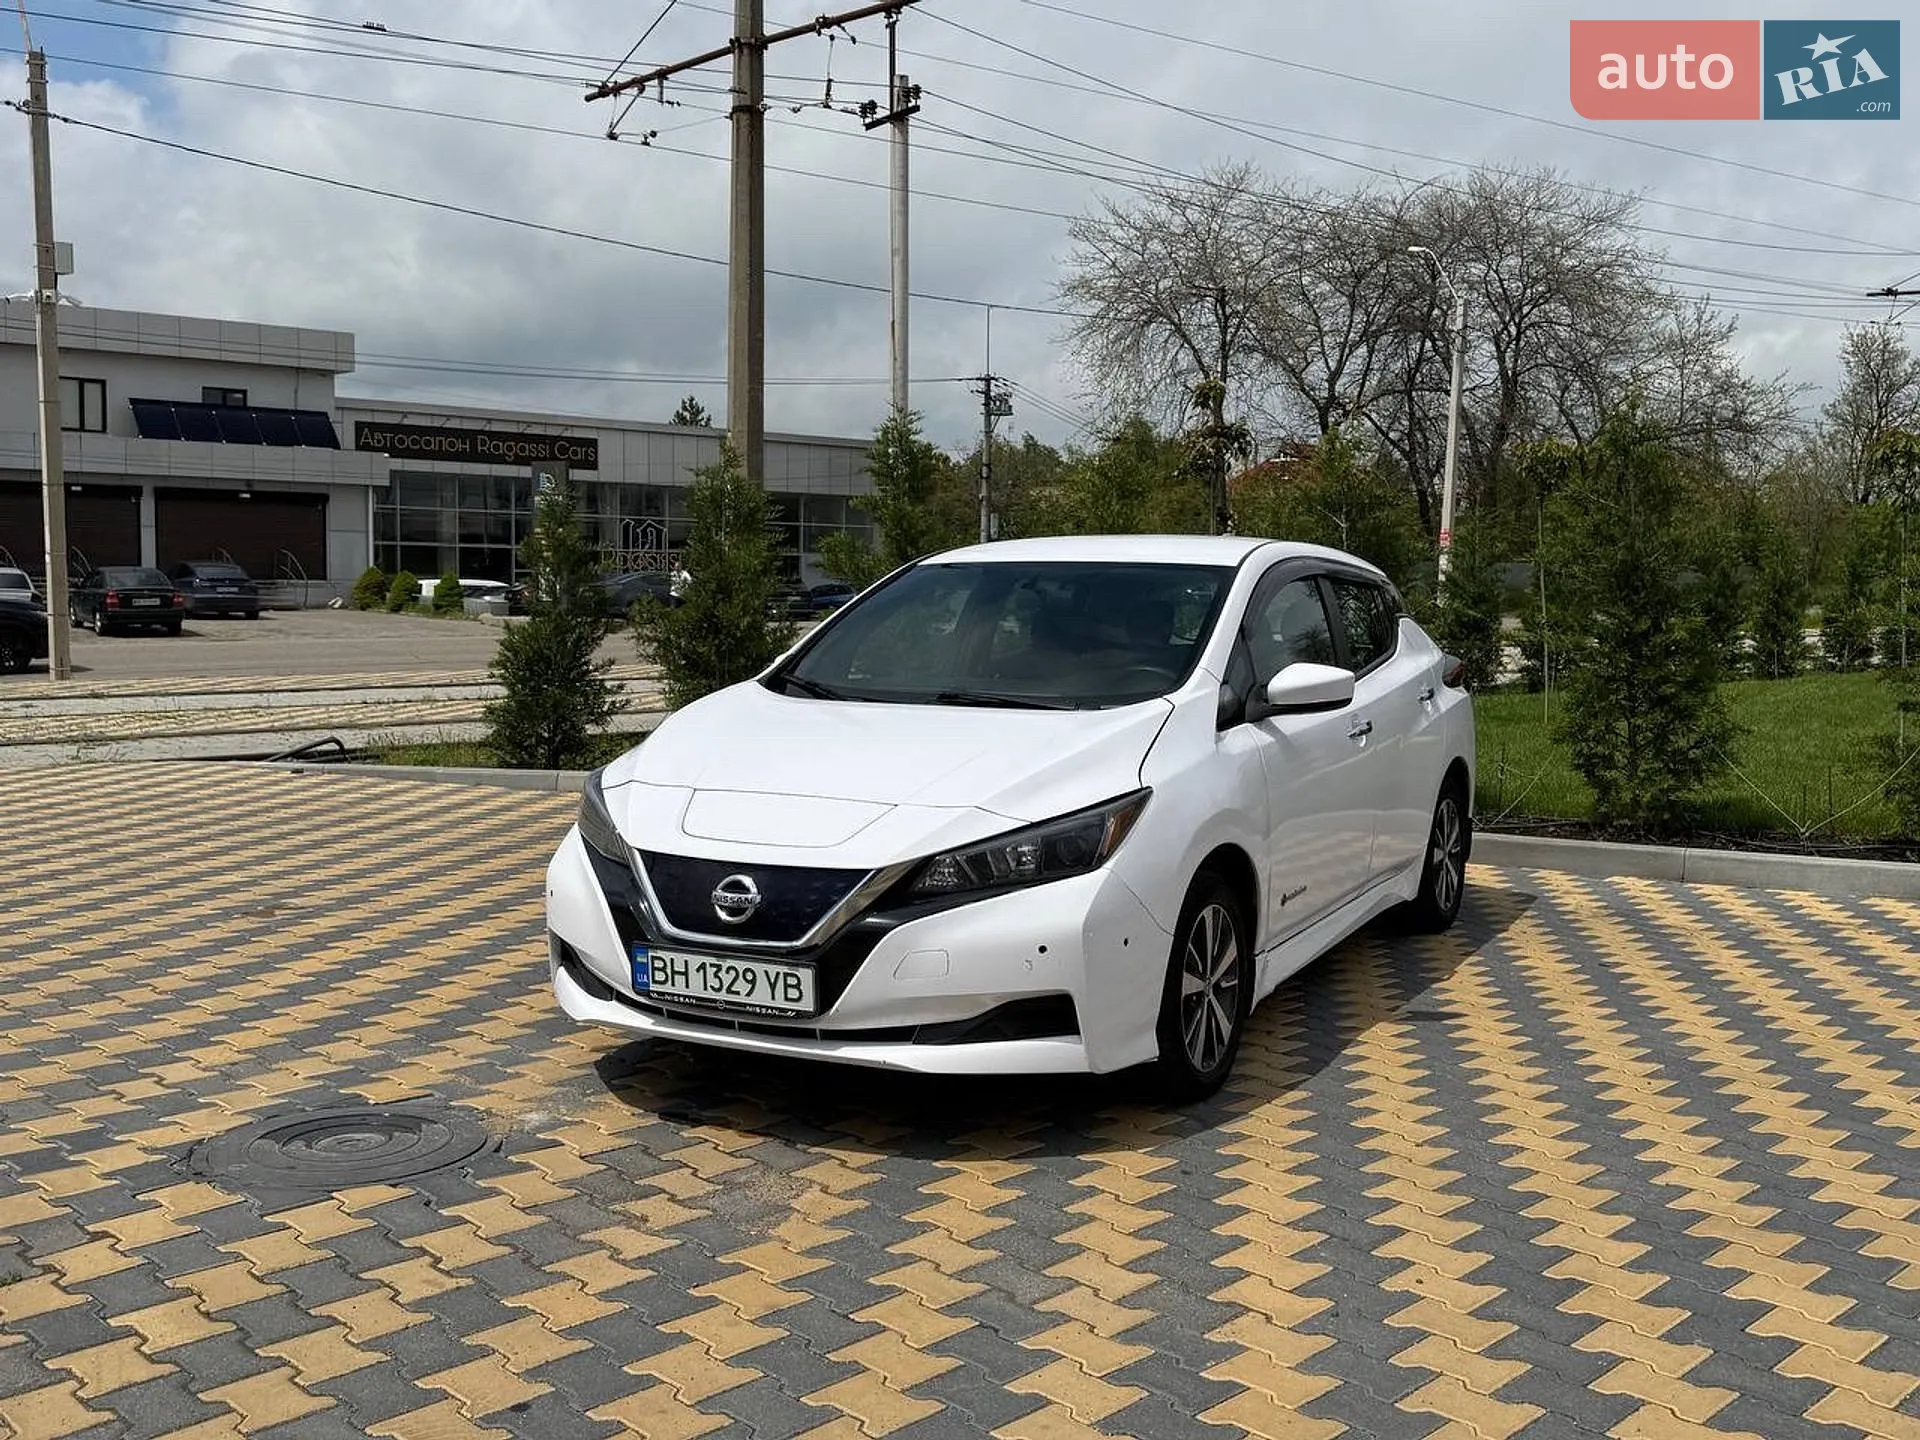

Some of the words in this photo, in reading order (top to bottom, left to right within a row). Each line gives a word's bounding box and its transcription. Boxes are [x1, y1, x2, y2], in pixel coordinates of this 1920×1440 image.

[477, 435, 550, 462] Ragassi
[554, 441, 596, 460] Cars
[637, 973, 649, 984] UA
[650, 955, 690, 989] BH
[696, 961, 757, 997] 1329
[764, 970, 804, 1002] YB
[664, 995, 696, 1004] NISSAN
[746, 1006, 779, 1015] NISSAN
